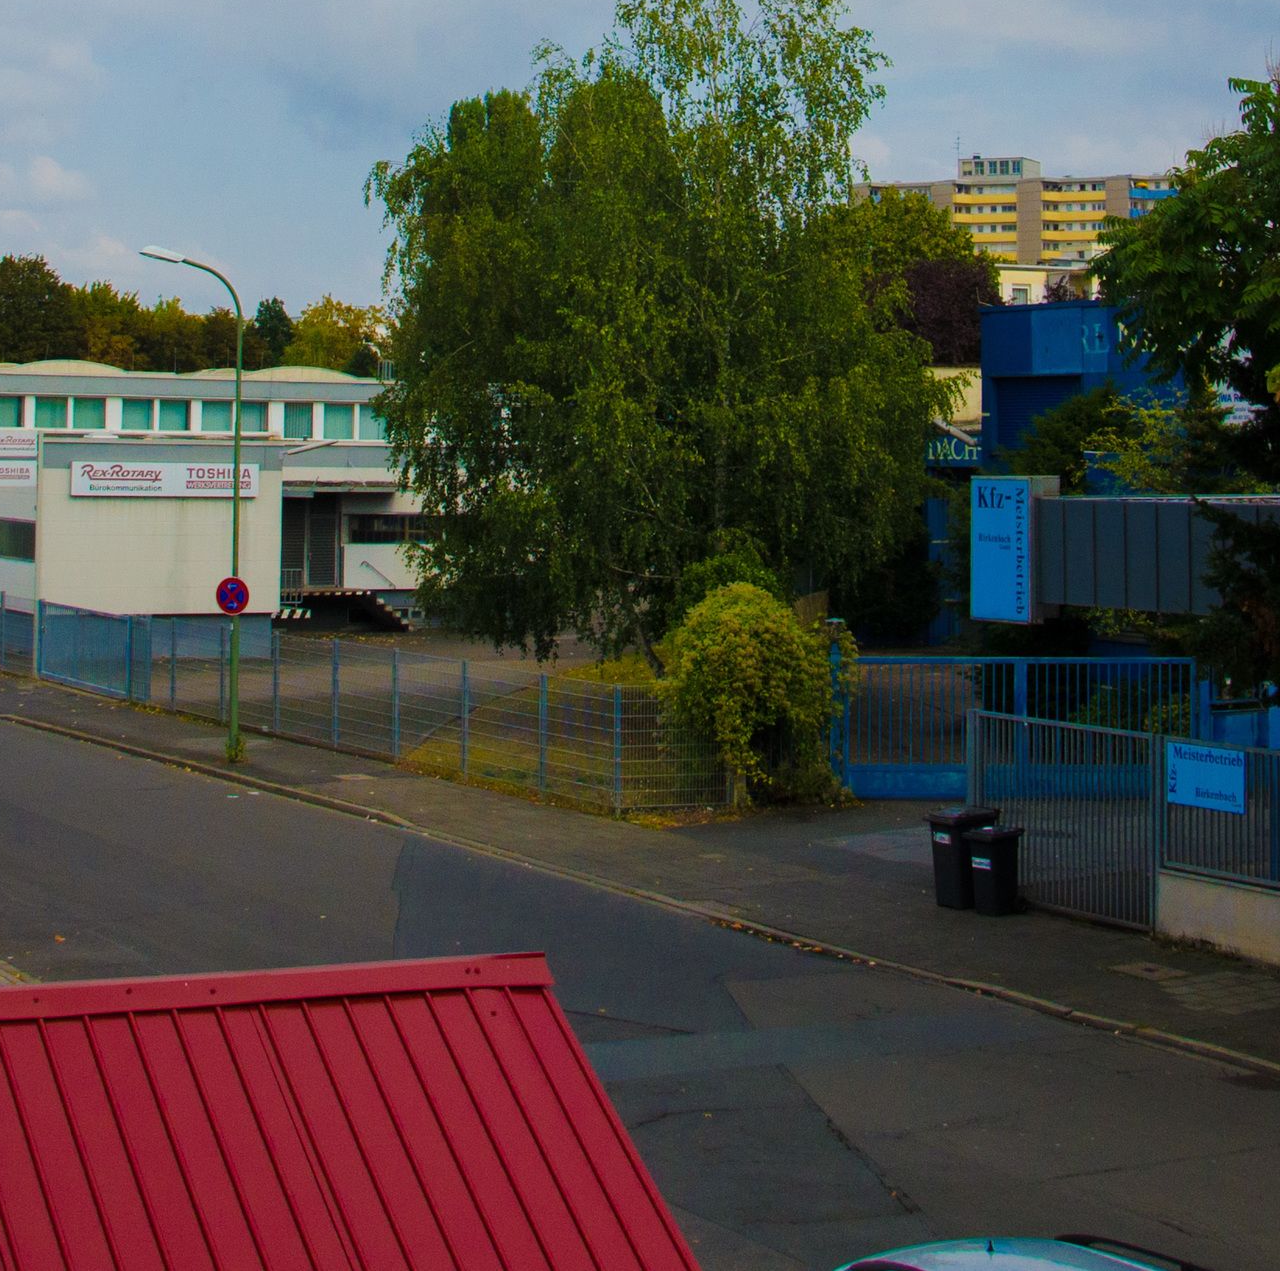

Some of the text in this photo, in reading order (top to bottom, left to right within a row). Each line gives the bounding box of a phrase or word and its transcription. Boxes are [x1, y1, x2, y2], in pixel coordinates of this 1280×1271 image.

[89, 484, 163, 492] Bürokommunikation
[977, 486, 1012, 509] Kfz-
[1015, 488, 1025, 614] Meisterbetrieb
[1173, 744, 1243, 767] Meisterbetrieb
[1169, 764, 1177, 793] Kfz-
[1195, 787, 1237, 803] Birkenbach
